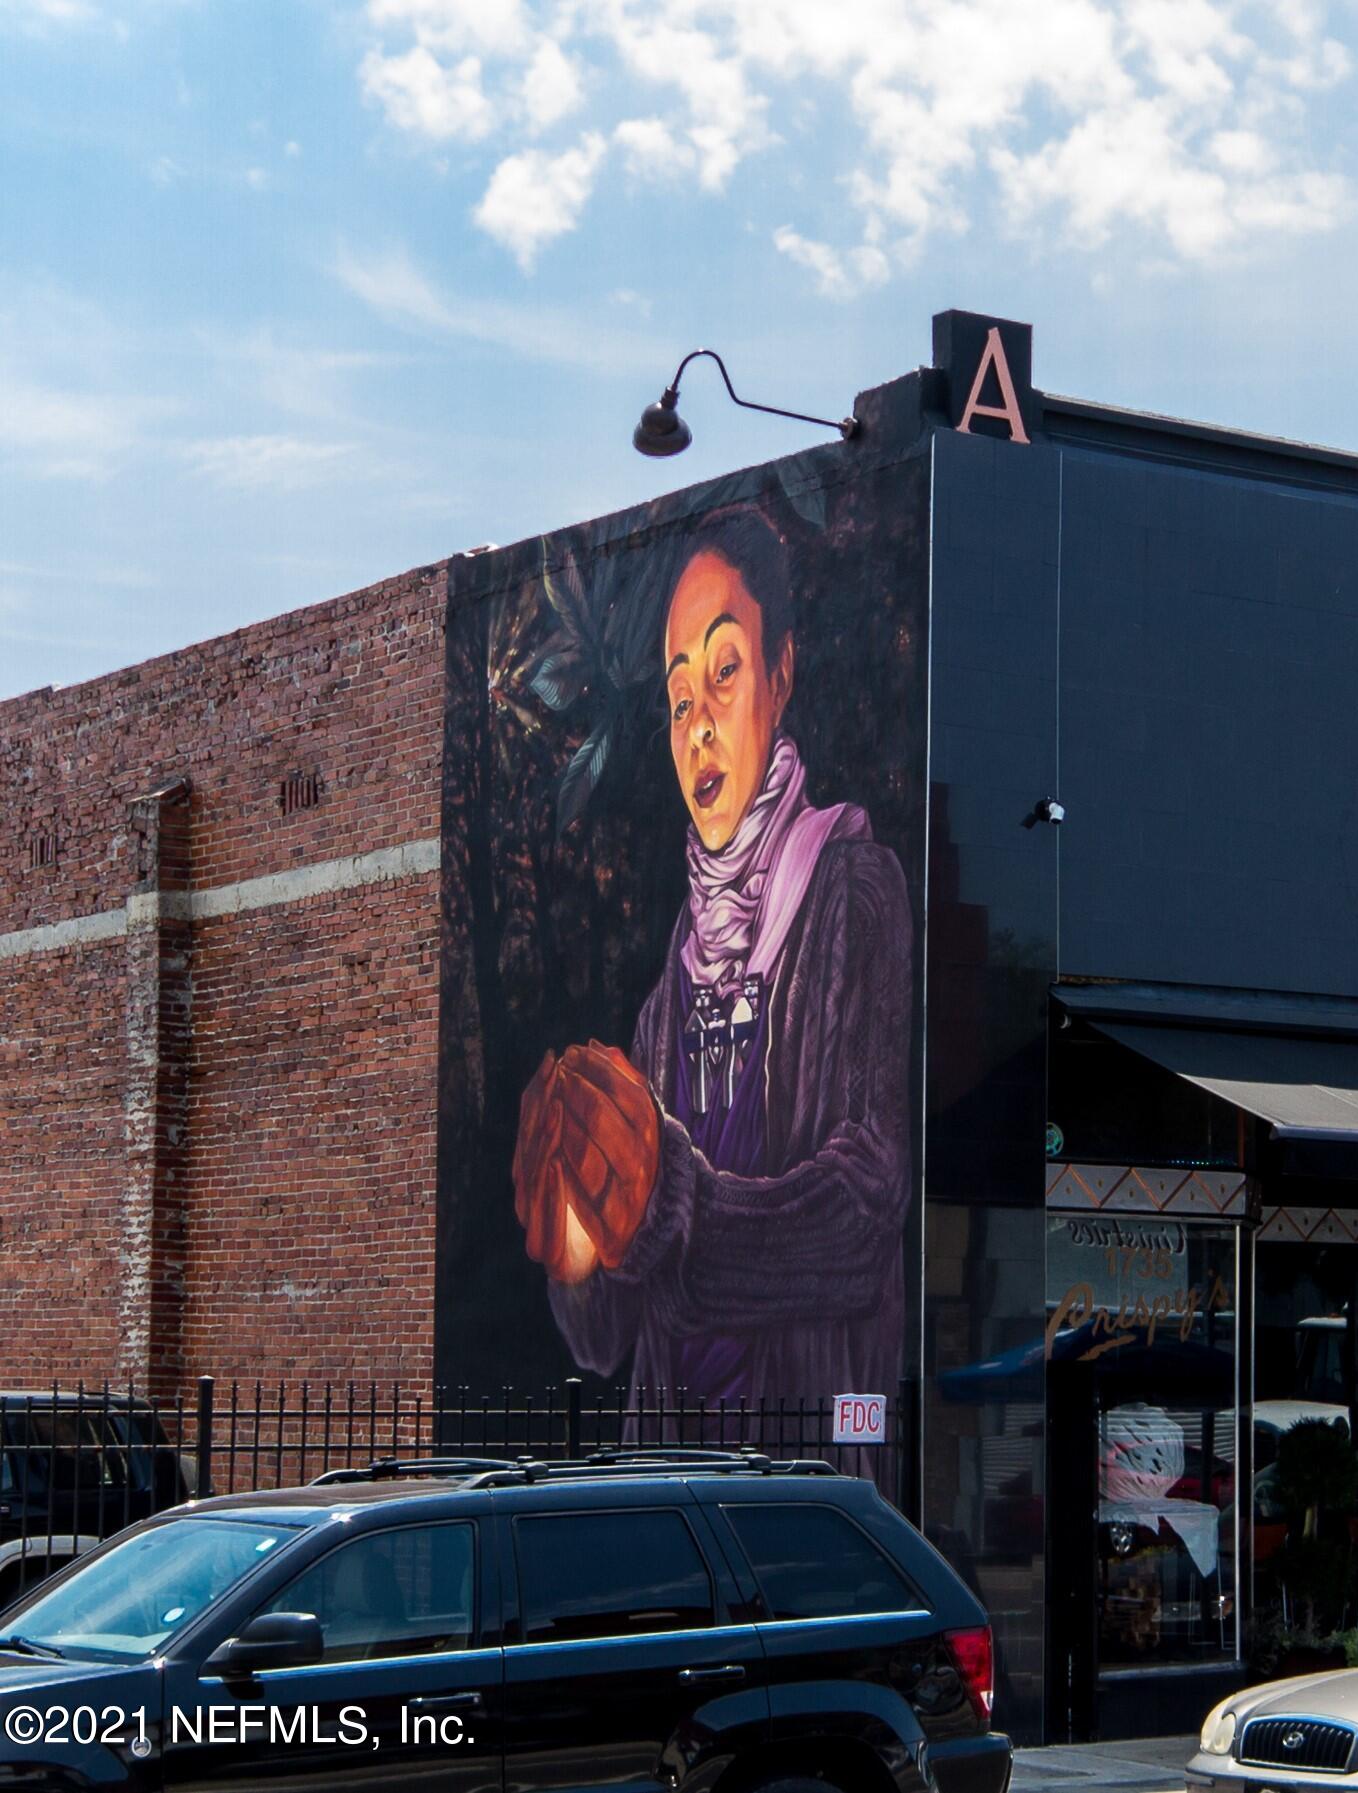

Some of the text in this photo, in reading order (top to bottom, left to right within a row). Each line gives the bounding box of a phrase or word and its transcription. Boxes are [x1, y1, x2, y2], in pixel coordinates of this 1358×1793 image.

[955, 326, 1031, 444] A
[1105, 1247, 1174, 1280] 1735
[1045, 1266, 1230, 1361] Crispy's
[839, 1401, 880, 1433] FDC
